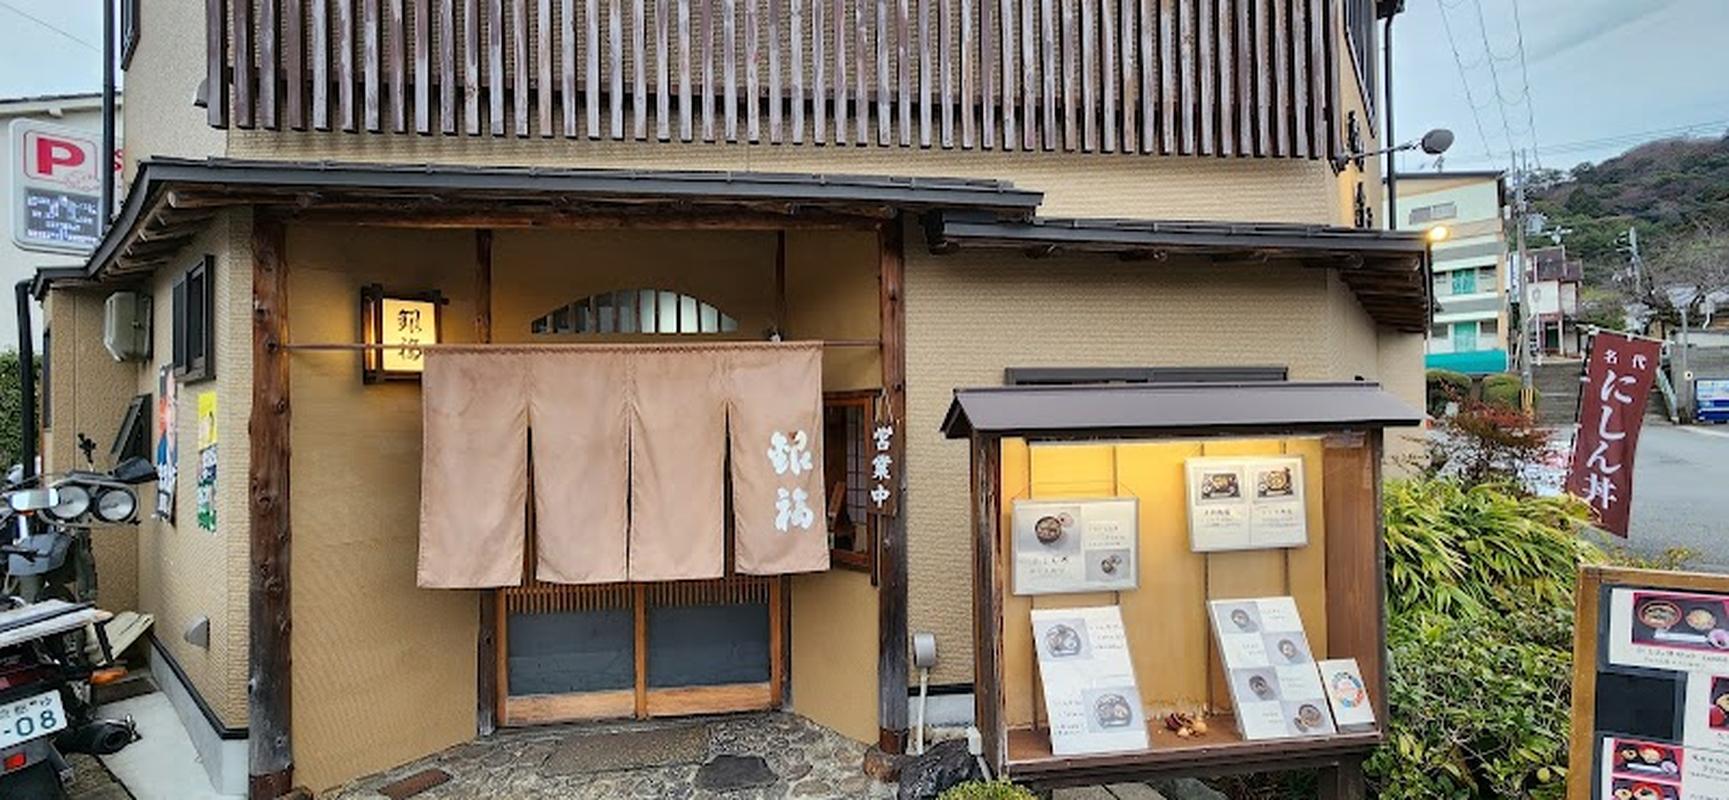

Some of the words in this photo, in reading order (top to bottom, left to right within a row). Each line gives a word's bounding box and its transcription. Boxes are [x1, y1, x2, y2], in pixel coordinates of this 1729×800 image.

[36, 136, 85, 176] P
[1603, 349, 1649, 370] 名代
[870, 425, 894, 509] 営業中
[1581, 368, 1638, 511] にしん丼
[767, 429, 814, 533] 銀福
[3, 709, 58, 737] -08
